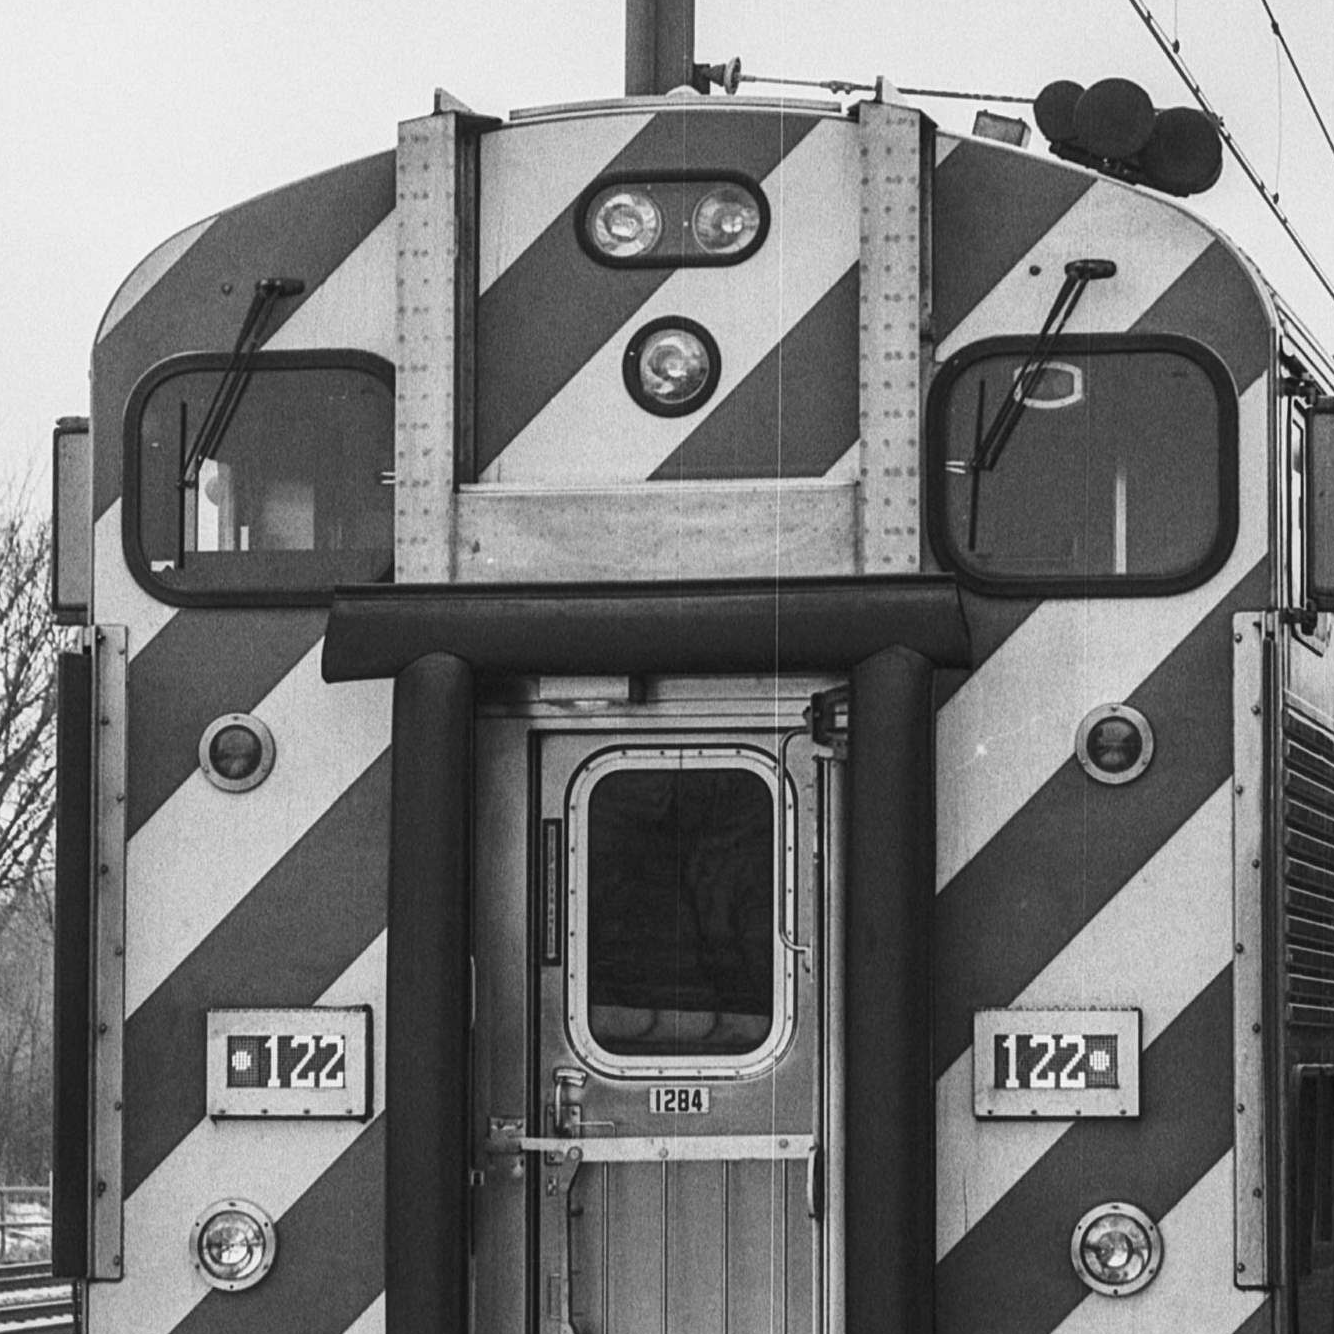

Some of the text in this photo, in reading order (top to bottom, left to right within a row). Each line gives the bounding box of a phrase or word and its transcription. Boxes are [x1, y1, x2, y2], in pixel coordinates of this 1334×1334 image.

[264, 1034, 345, 1088] 122
[1002, 1034, 1086, 1089] 122
[656, 1089, 703, 1112] 1284
